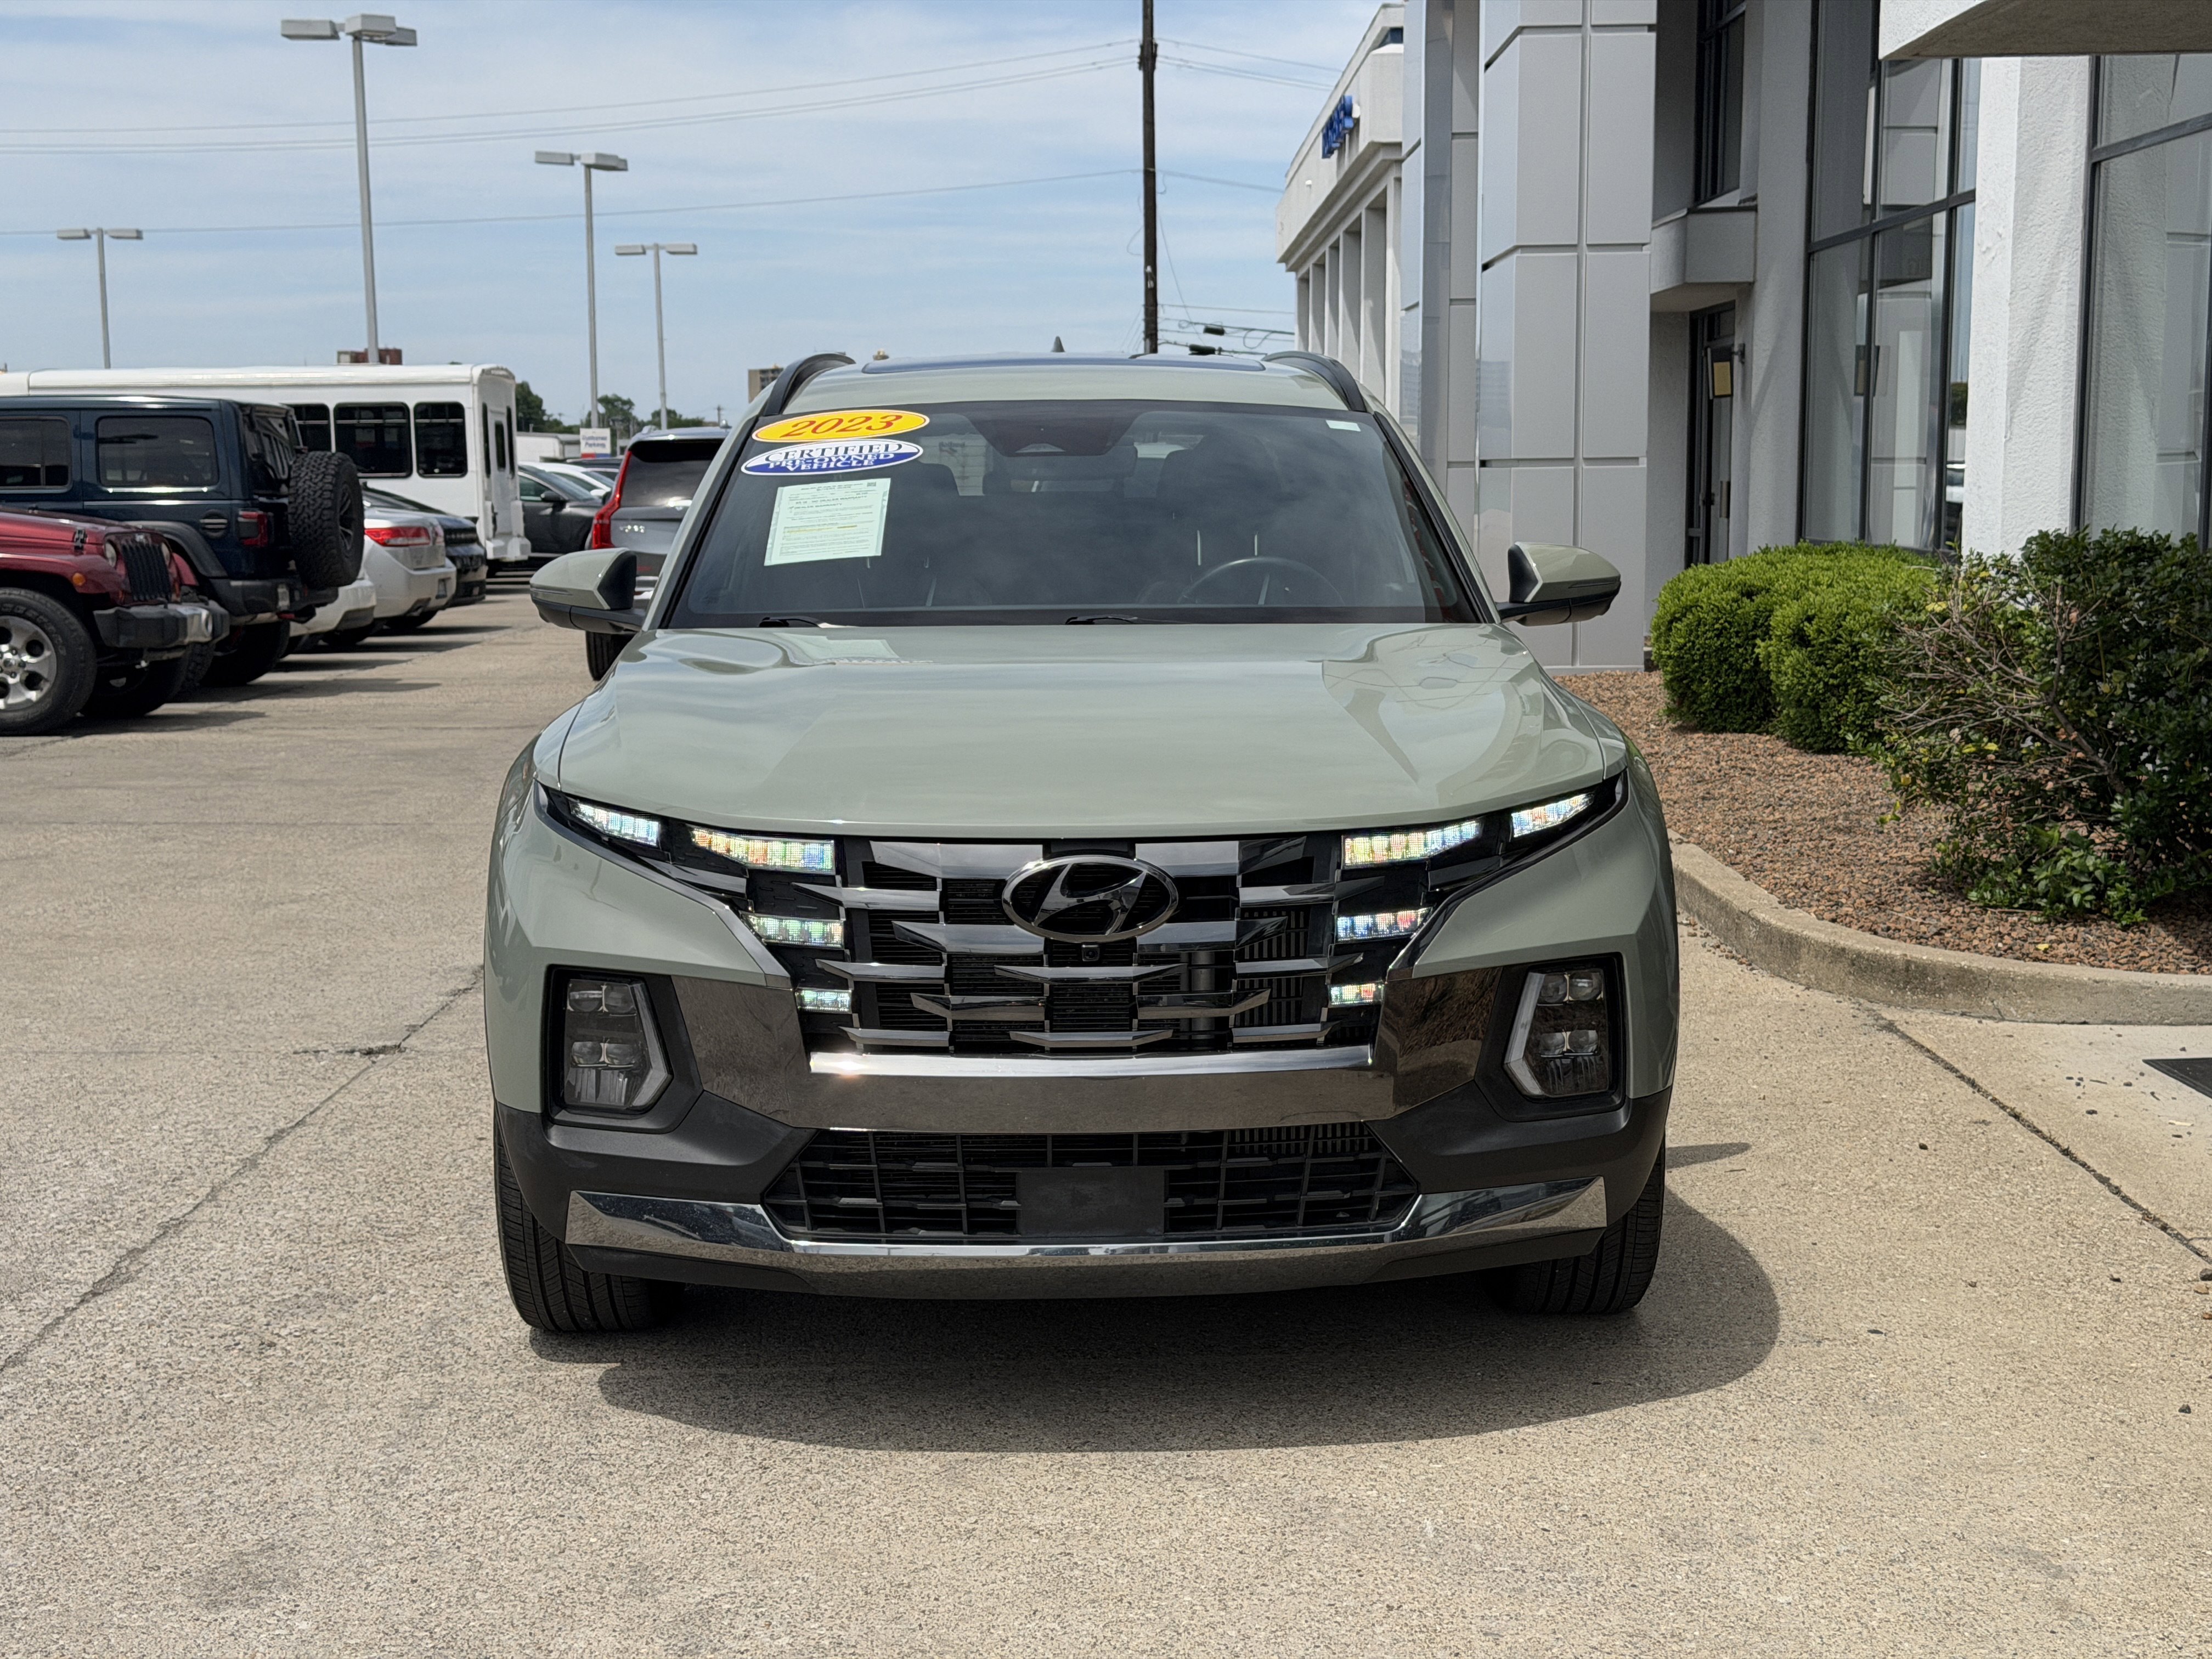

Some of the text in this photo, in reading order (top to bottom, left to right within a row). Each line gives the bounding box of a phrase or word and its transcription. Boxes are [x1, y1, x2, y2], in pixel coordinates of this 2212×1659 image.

[780, 415, 903, 438] 2023
[765, 443, 903, 462] CERTIFIED
[768, 453, 895, 469] PRE-OWNED
[786, 459, 875, 471] VEHICLE
